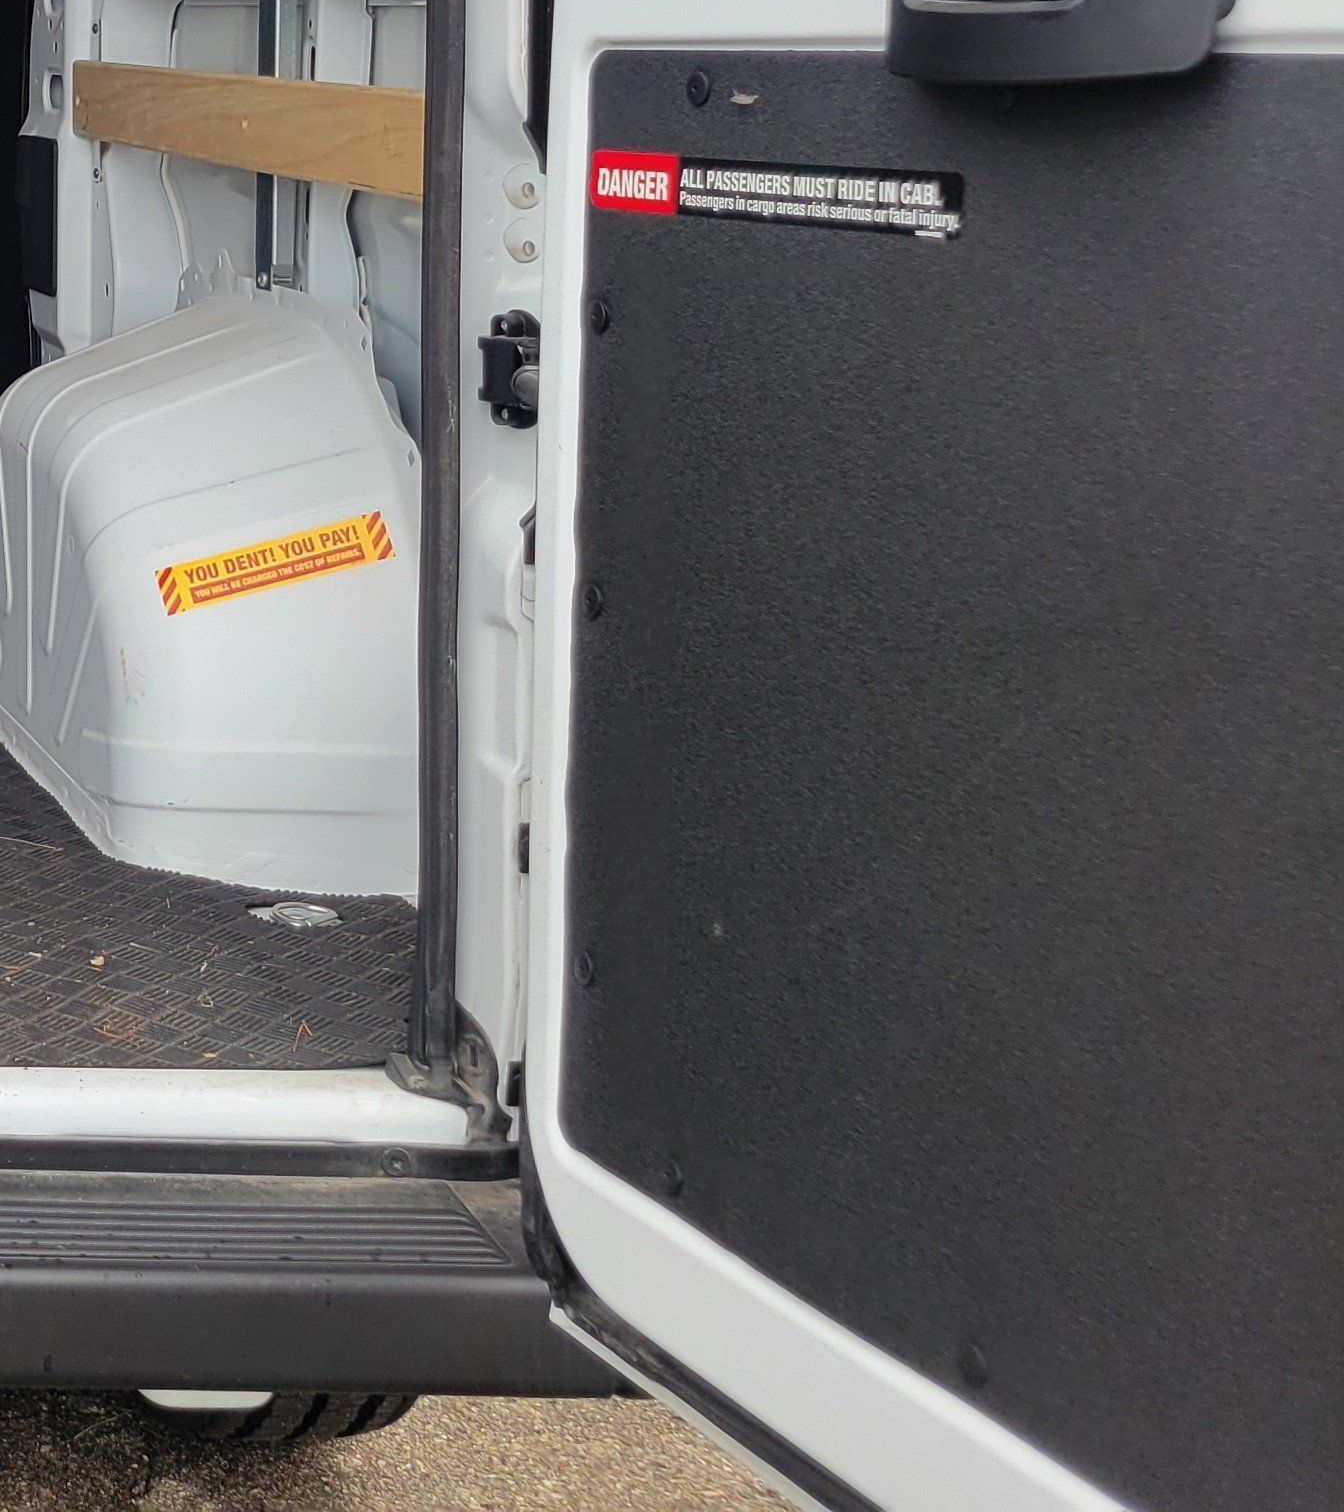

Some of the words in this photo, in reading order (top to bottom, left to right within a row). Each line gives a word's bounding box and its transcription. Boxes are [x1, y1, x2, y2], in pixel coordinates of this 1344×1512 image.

[597, 167, 670, 201] DANGER
[679, 168, 704, 189] ALL
[706, 169, 791, 196] PASSENGERS
[792, 176, 837, 199] MUST
[837, 178, 877, 202] RIDE
[878, 181, 897, 203] IN
[900, 182, 942, 206] CAB.
[679, 190, 735, 211] Passengers
[735, 195, 746, 211] in
[746, 199, 775, 216] cargo
[776, 201, 806, 216] areas
[807, 201, 829, 218] risk
[829, 203, 873, 221] serious
[873, 209, 888, 223] or
[888, 207, 917, 225] fatal
[917, 209, 961, 231] injury.
[183, 560, 220, 584] YOU
[223, 548, 276, 574] DENT!
[278, 537, 315, 558] YOU
[318, 525, 360, 549] PAY!
[194, 587, 211, 598] YOU
[211, 583, 230, 593] WILL
[230, 580, 241, 589] BE
[241, 569, 278, 586] CHARGED
[278, 565, 294, 576] THE
[294, 560, 314, 572] COST
[314, 557, 326, 566] OF
